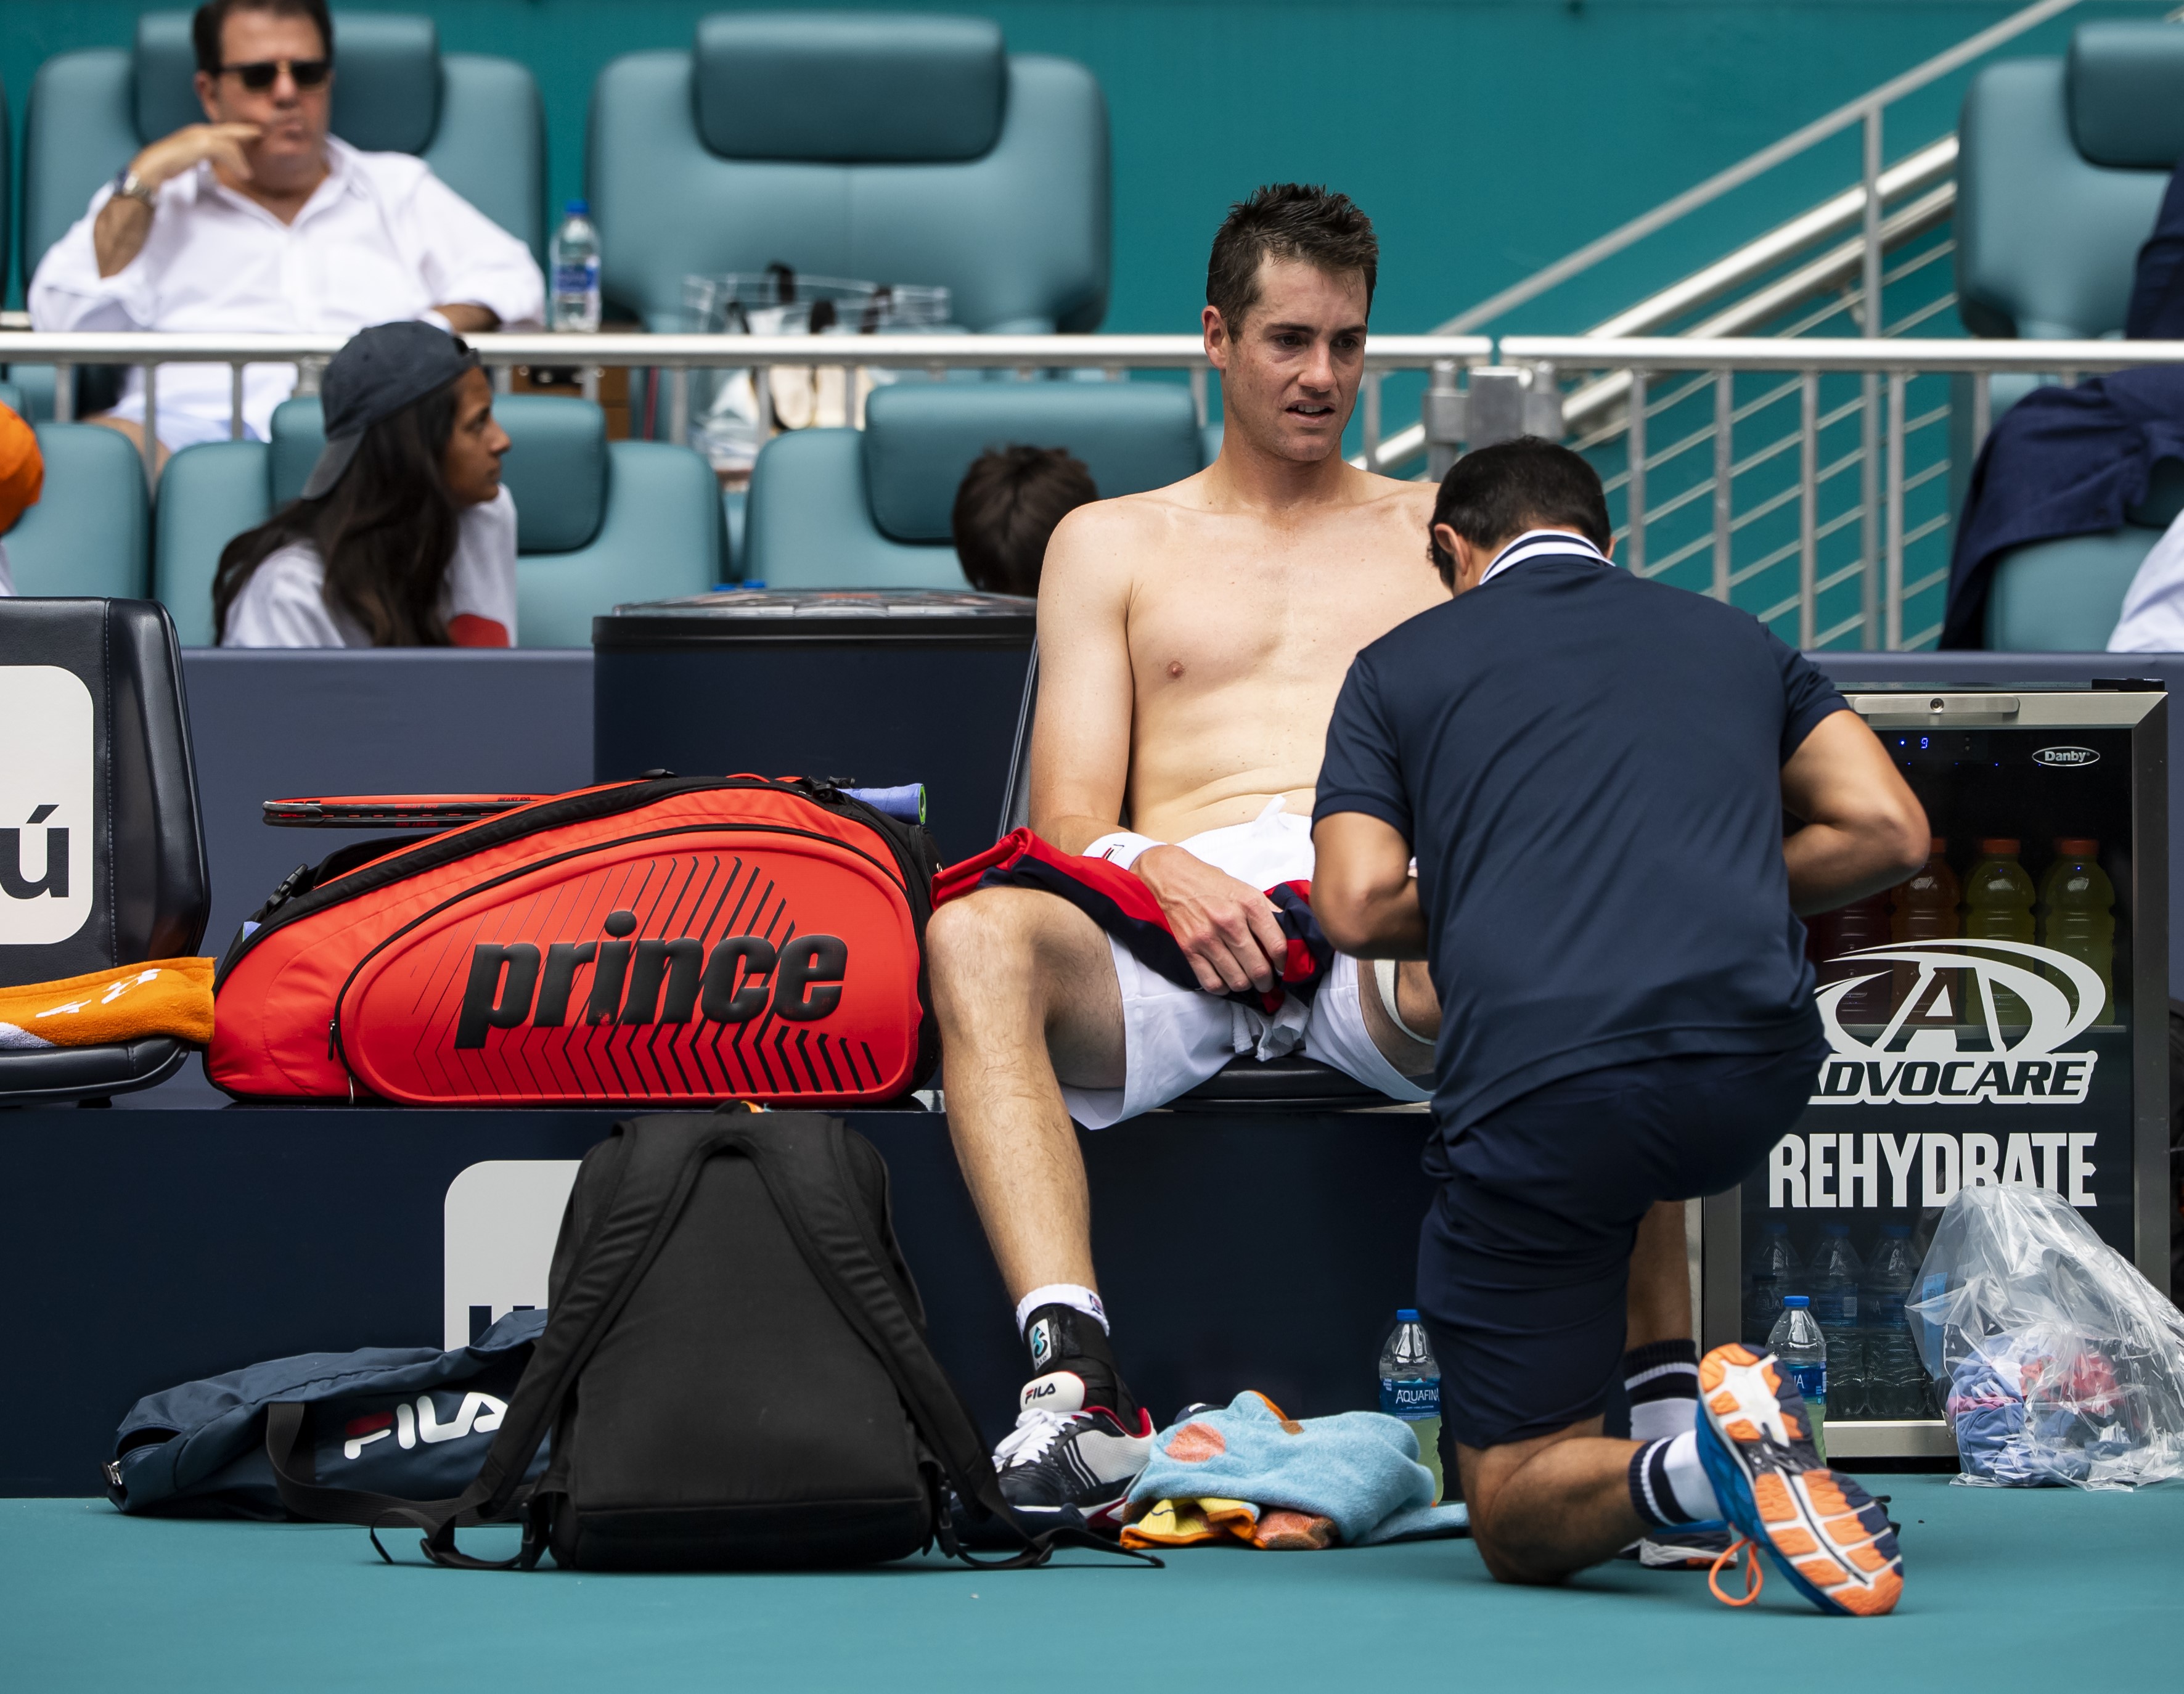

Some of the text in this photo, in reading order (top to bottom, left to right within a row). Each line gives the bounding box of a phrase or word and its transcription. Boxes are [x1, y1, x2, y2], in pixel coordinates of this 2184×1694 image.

[2045, 750, 2086, 763] Danby
[454, 910, 848, 1049] prince
[1812, 1061, 2087, 1096] DVOCARE
[1769, 1132, 2098, 1208] REHYDRATE
[1025, 1383, 1056, 1404] FILA
[1395, 1387, 1440, 1404] AQUAFINA
[344, 1391, 509, 1460] FILA
